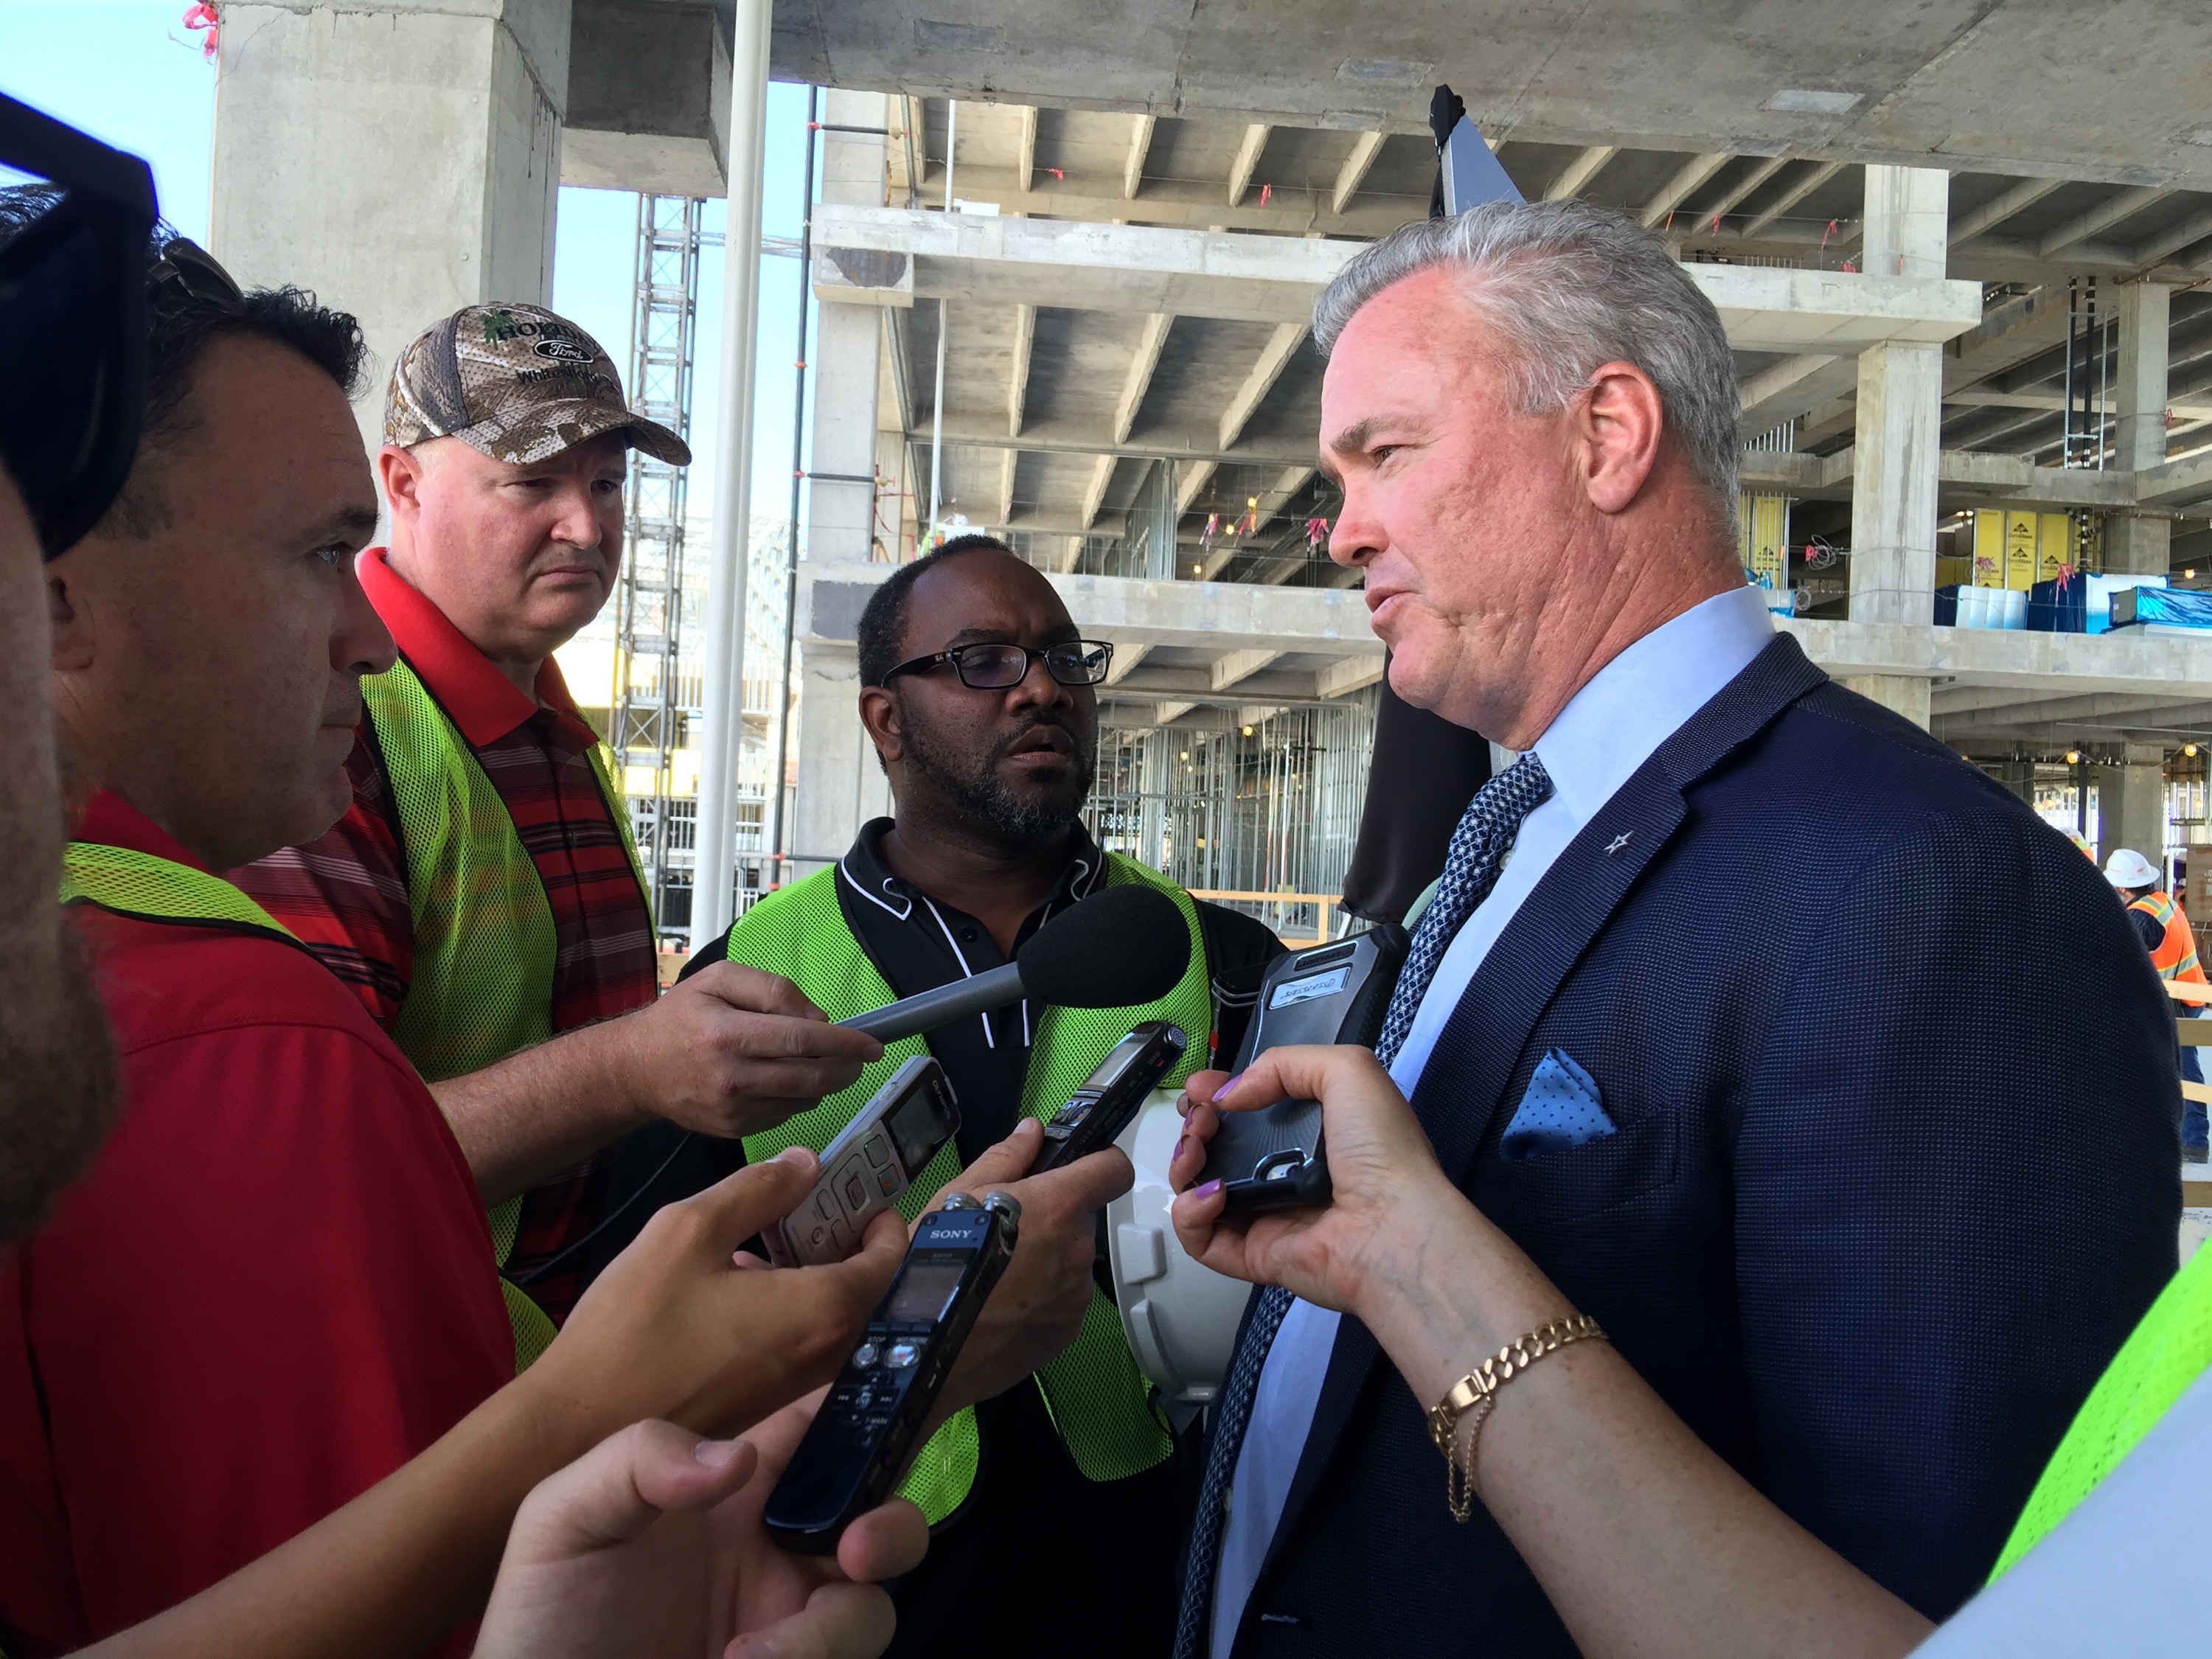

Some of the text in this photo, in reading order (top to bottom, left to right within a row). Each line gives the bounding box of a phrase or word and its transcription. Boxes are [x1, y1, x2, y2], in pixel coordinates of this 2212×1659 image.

[549, 342, 584, 360] Ford
[932, 1079, 950, 1120] OLYMPUS
[929, 1229, 973, 1239] SONY
